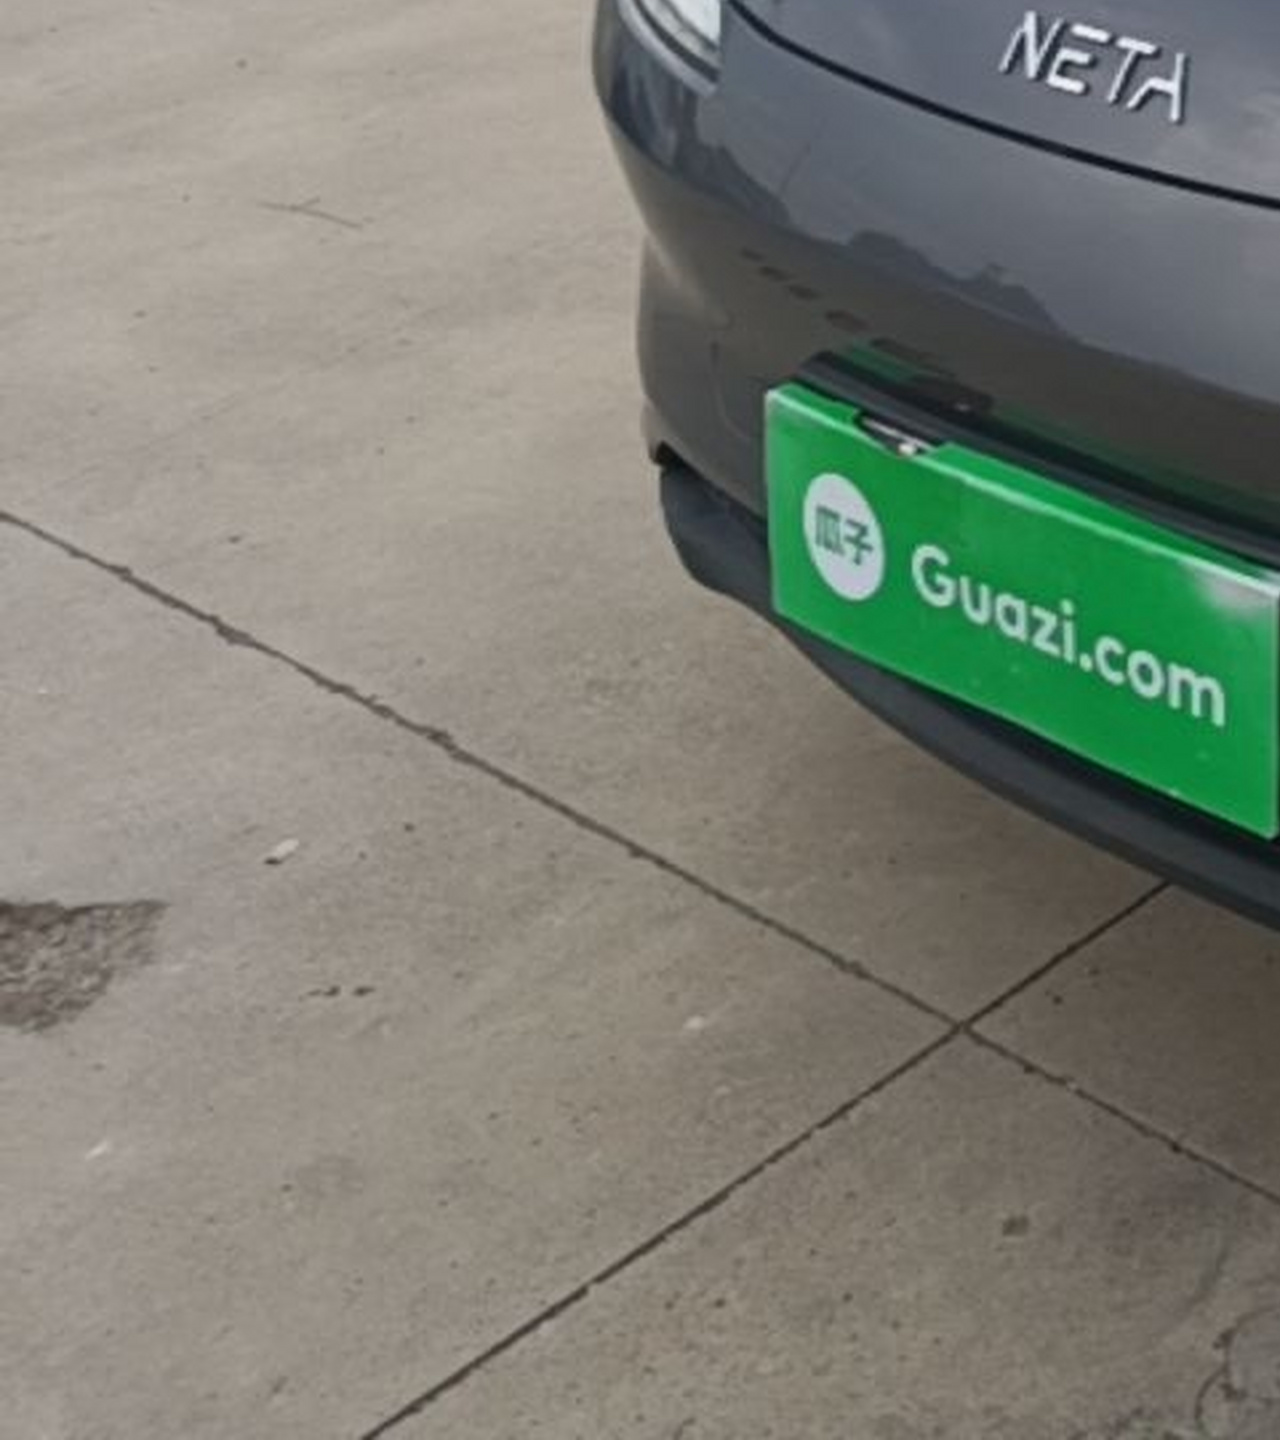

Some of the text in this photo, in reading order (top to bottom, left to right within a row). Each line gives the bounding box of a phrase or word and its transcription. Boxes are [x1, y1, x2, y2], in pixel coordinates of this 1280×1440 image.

[998, 9, 1187, 124] NETA
[815, 504, 874, 566] 瓜子
[911, 544, 1226, 728] Guazi.com
